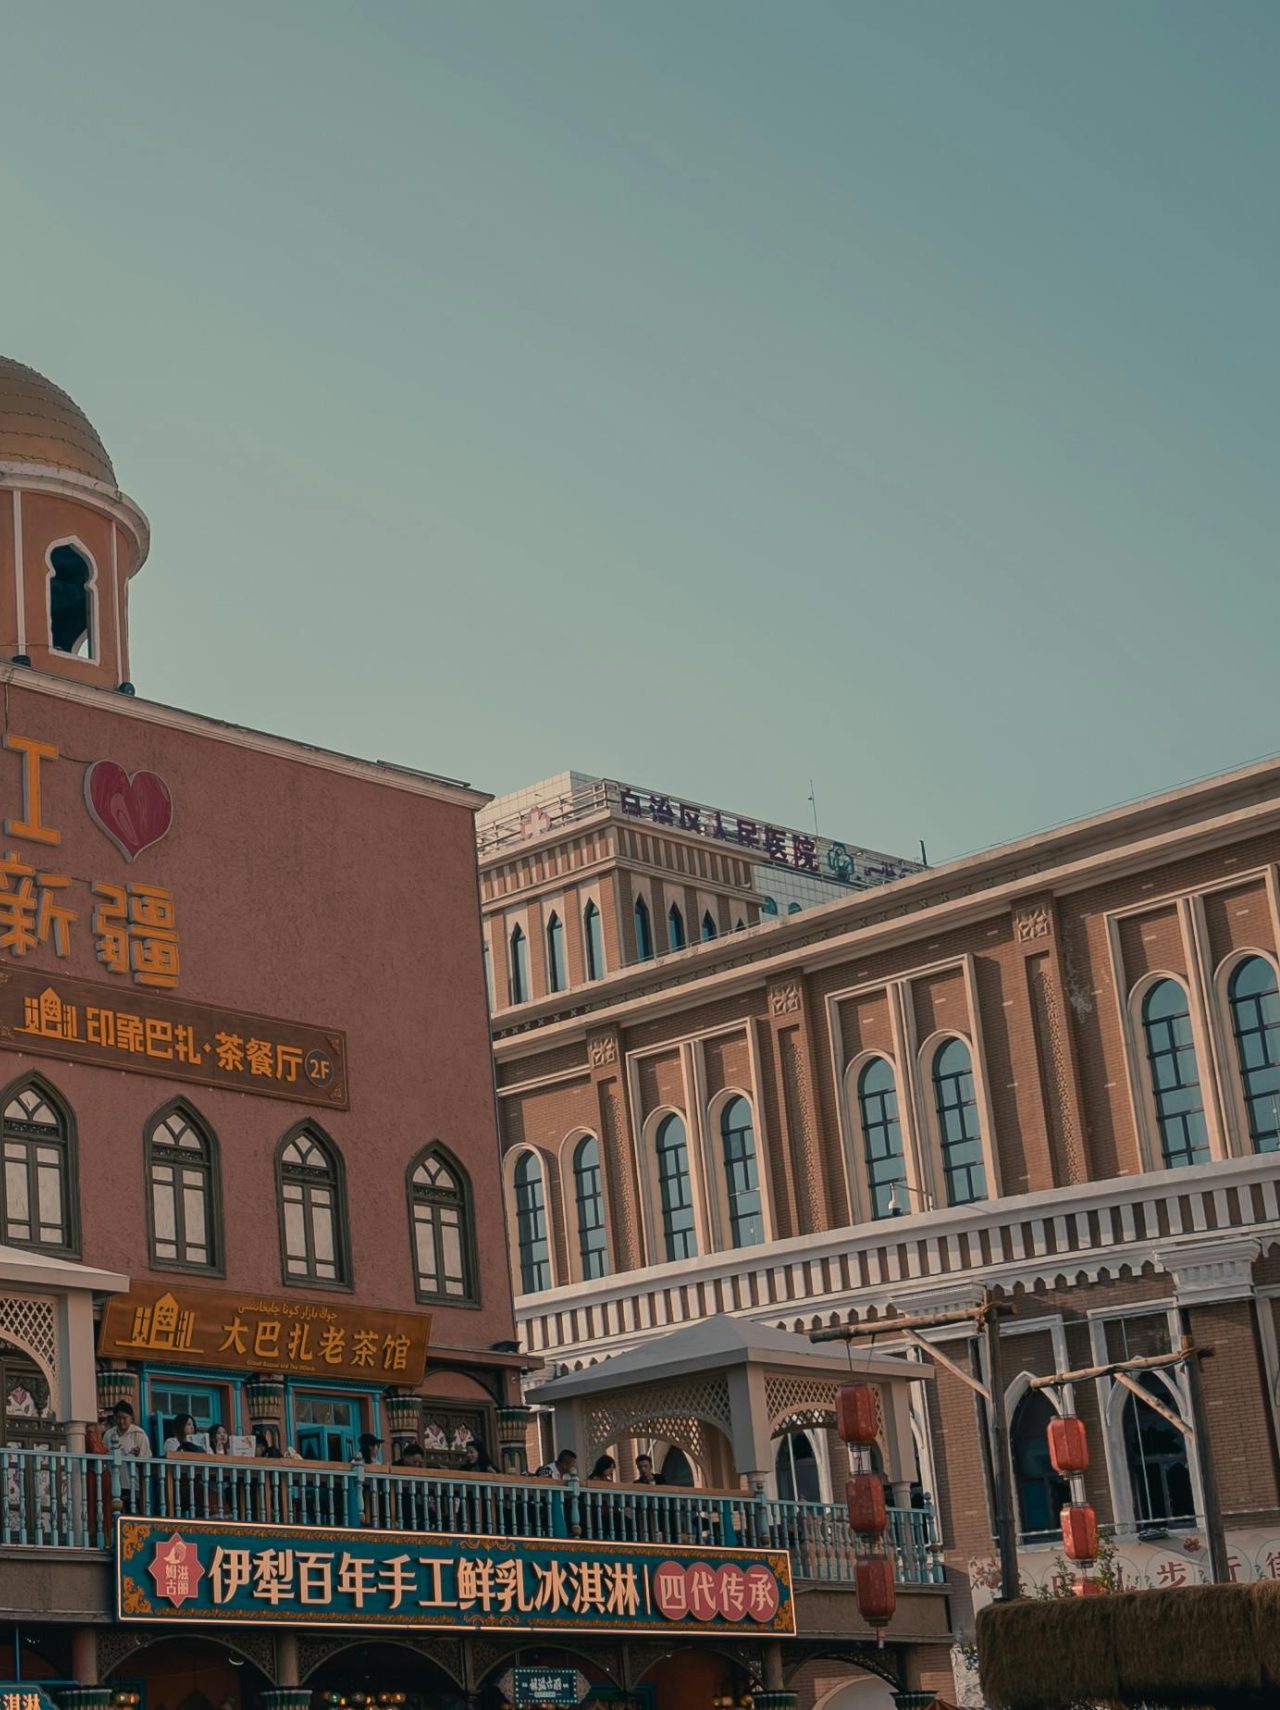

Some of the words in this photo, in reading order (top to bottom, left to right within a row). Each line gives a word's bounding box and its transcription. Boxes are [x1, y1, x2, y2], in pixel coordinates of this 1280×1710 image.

[621, 787, 820, 872] 自治区人民医院
[310, 1057, 330, 1079] 2F
[218, 1315, 411, 1371] 大巴扎老茶馆
[208, 1545, 640, 1616] 伊犁百年手工鲜乳冰淇淋
[659, 1570, 775, 1613] 四代传承
